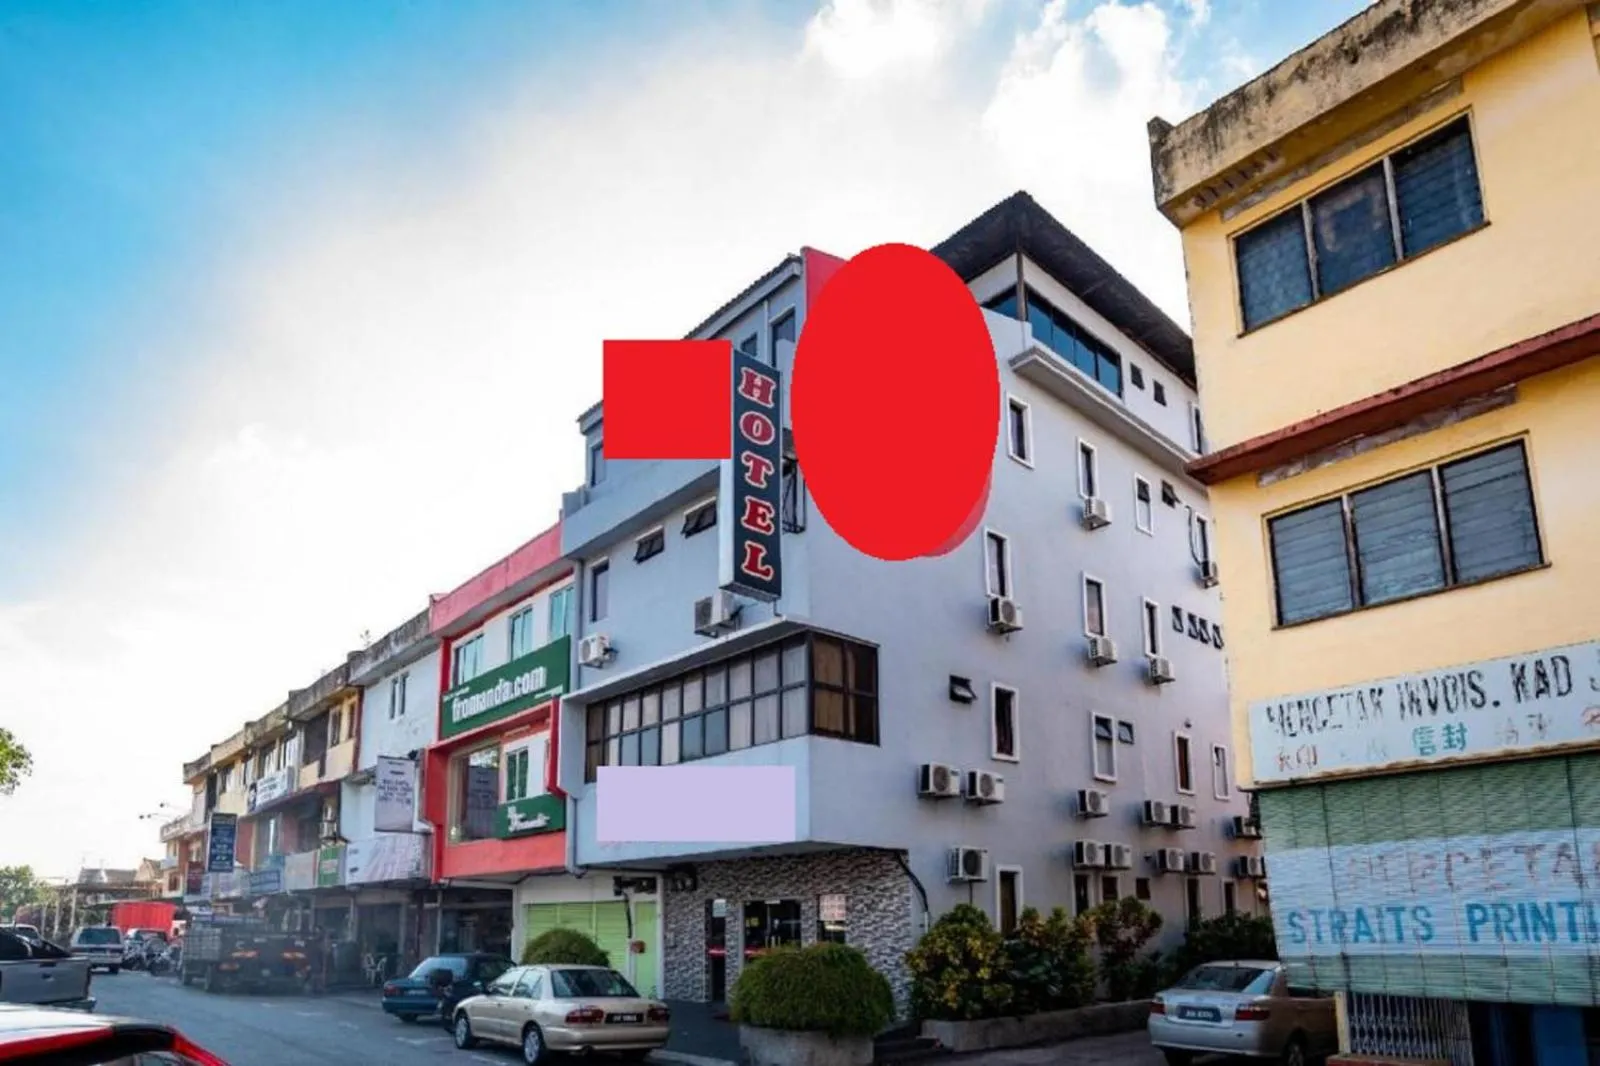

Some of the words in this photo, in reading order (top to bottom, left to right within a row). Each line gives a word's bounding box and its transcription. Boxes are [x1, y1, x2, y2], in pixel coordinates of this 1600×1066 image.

[738, 367, 776, 581] HOTEL
[1510, 655, 1572, 703] KAD
[1288, 905, 1434, 944] STRAITS
